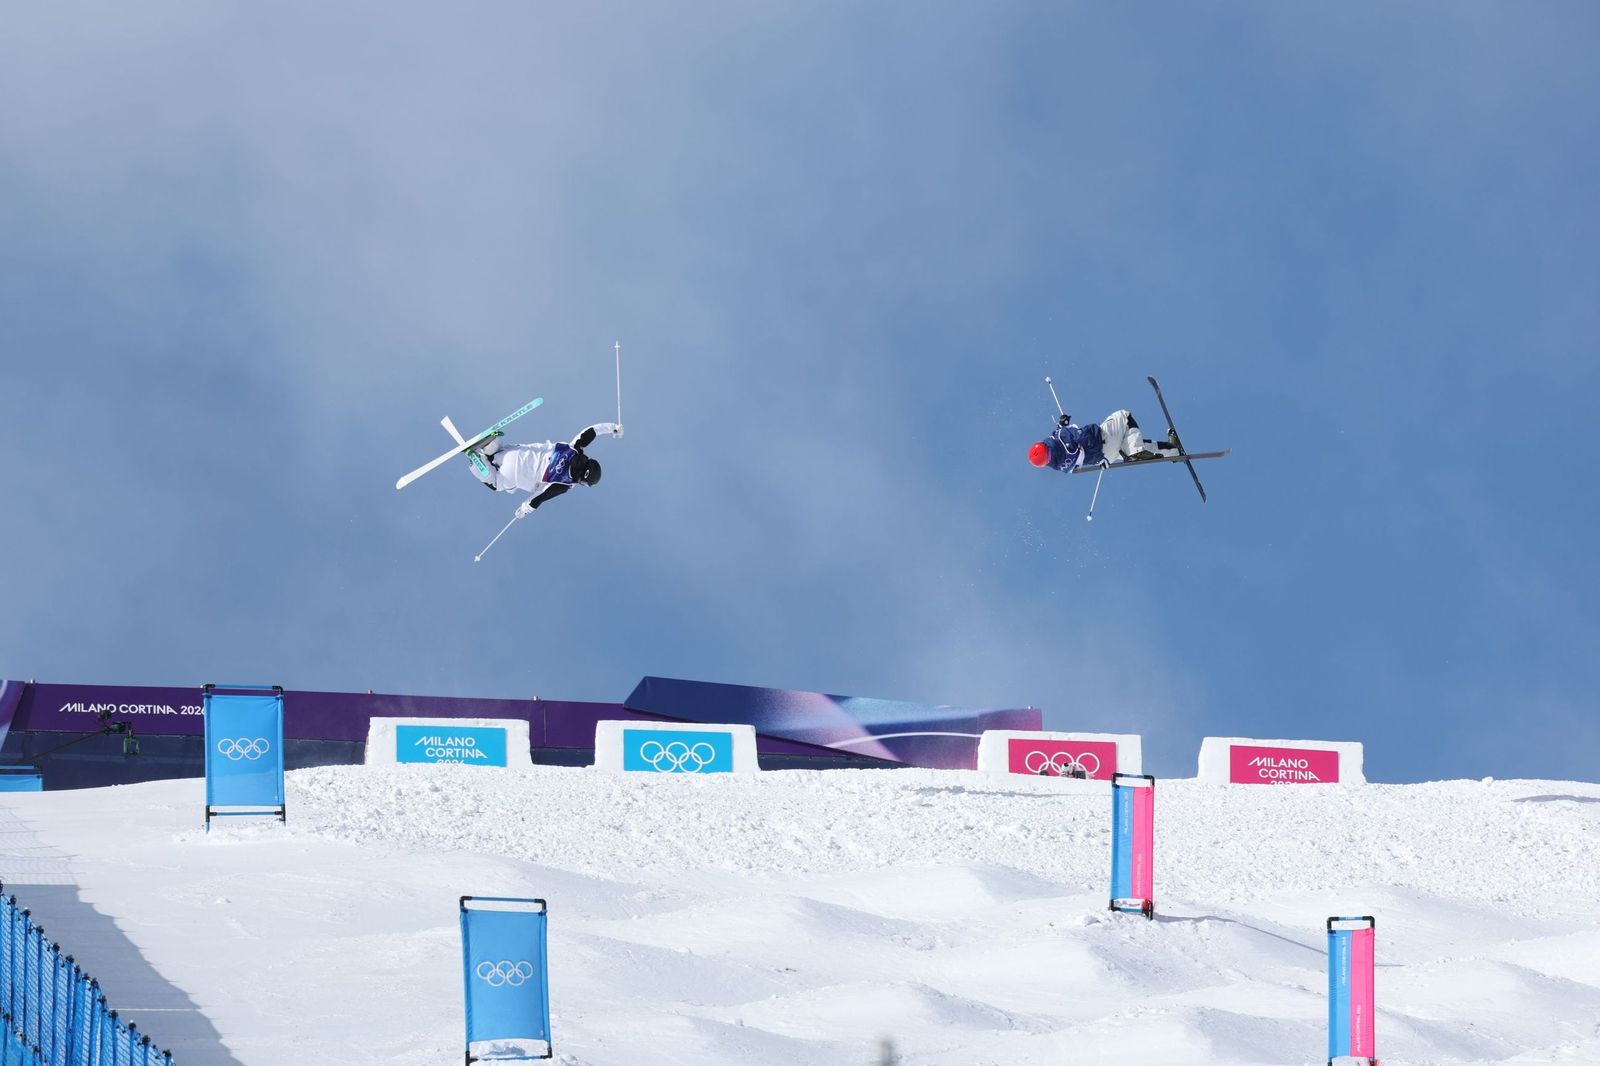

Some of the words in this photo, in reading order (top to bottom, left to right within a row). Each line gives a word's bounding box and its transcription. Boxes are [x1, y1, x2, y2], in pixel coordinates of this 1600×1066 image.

[59, 702, 117, 713] MILANO
[119, 704, 178, 715] CORTINA
[415, 736, 476, 747] MILANO
[425, 747, 488, 759] CORTINA
[1248, 756, 1308, 769] MILANO
[1258, 768, 1320, 781] CORTINA
